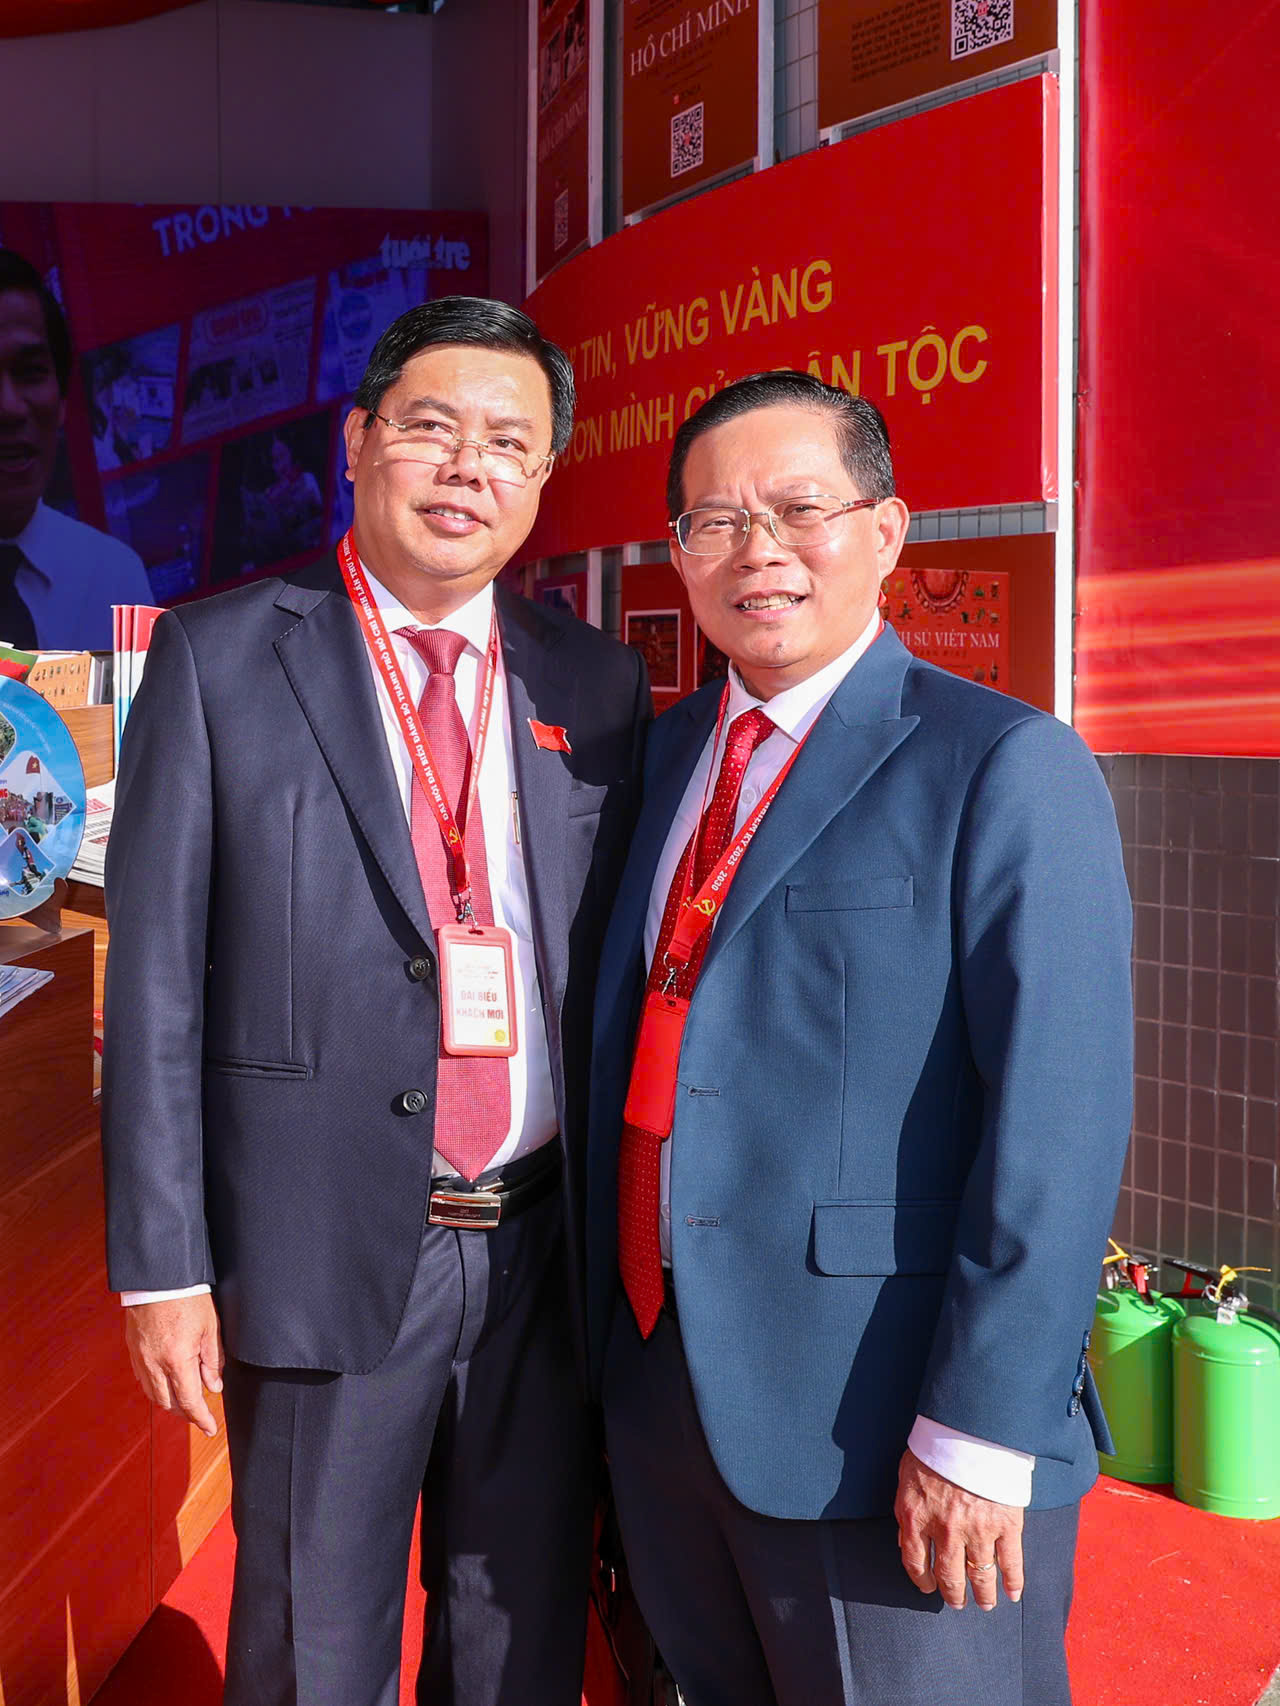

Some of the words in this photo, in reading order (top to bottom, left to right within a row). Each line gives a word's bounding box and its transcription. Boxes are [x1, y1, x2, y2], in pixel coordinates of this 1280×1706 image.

[152, 205, 270, 256] TRONG
[580, 330, 617, 382] TIN,
[624, 302, 710, 365] VỮNG
[720, 260, 833, 336] VÀNG
[877, 325, 988, 405] TỘC
[610, 393, 675, 453] MÌNH
[711, 870, 728, 891] 2030
[727, 845, 744, 867] 2025
